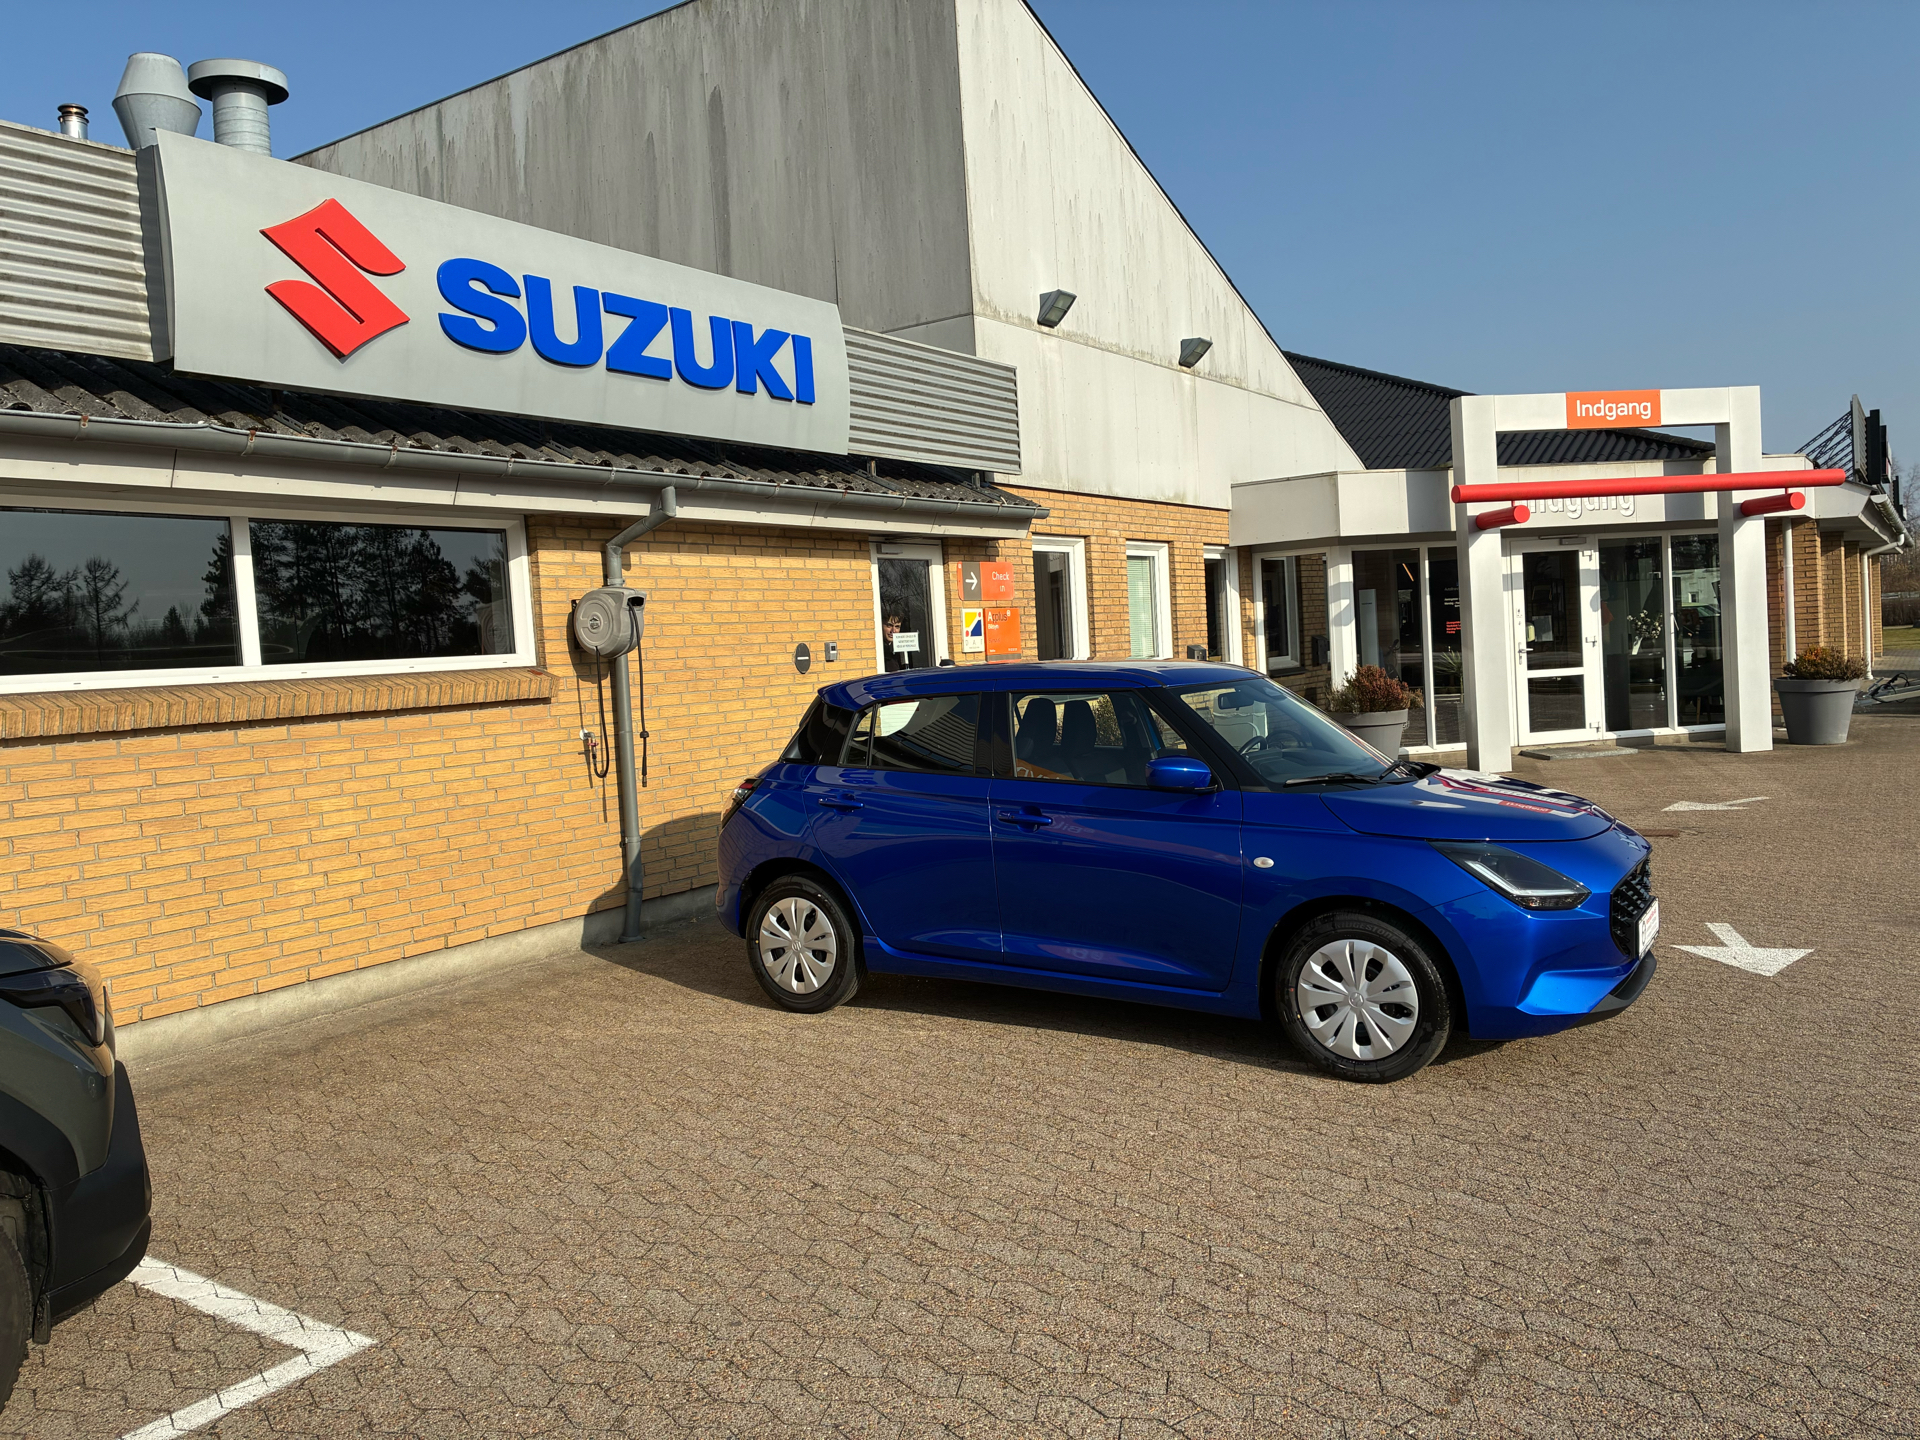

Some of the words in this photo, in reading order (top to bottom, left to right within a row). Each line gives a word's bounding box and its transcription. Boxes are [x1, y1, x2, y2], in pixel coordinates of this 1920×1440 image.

[437, 257, 816, 405] SUZUKI
[1576, 398, 1652, 421] Indgang
[1520, 494, 1636, 519] ngang
[991, 571, 1010, 581] Check
[1330, 920, 1399, 942] RIDGESTONE
